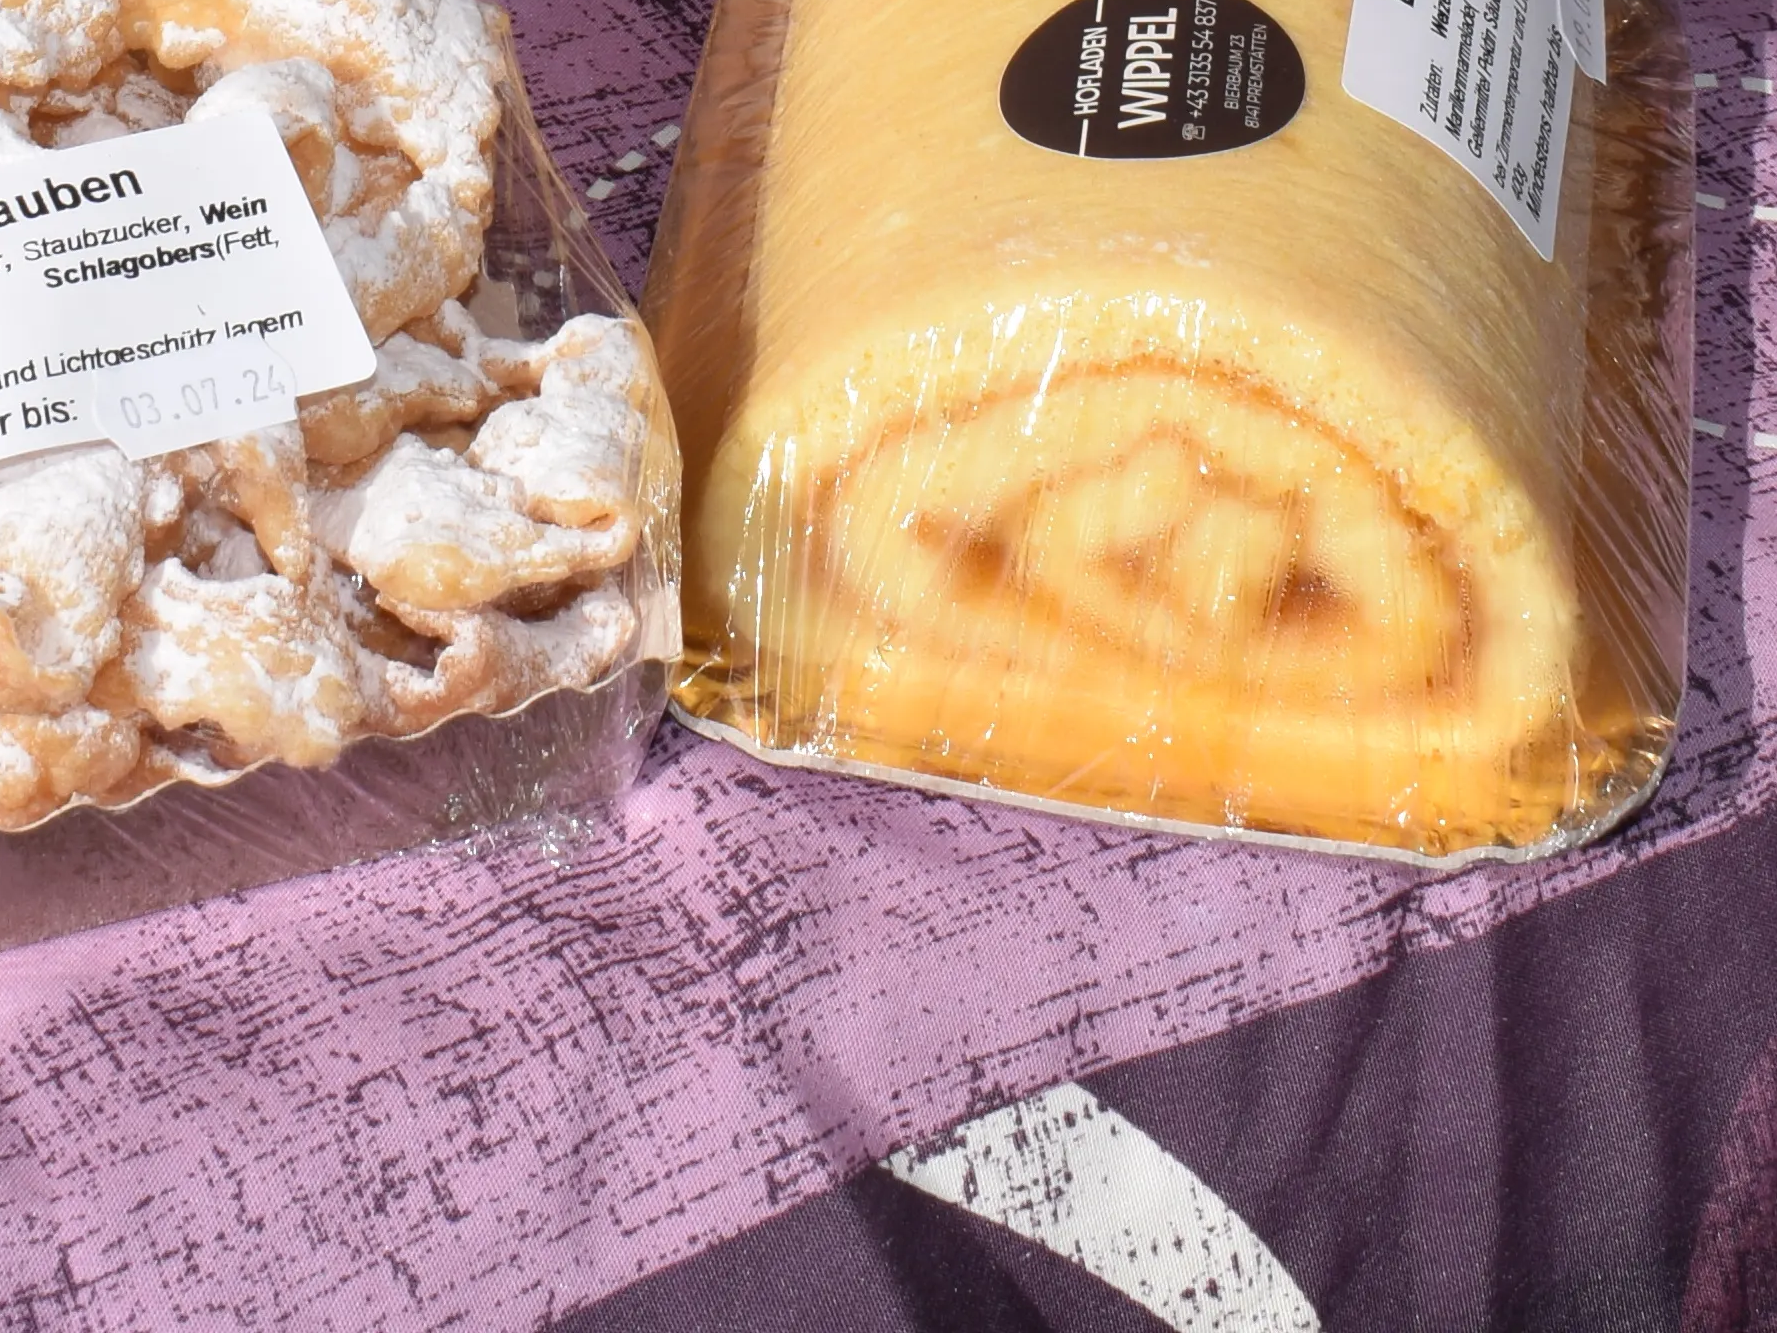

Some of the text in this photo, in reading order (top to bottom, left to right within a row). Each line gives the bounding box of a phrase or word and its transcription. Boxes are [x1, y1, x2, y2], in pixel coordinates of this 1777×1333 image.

[1075, 27, 1107, 114] HOFLADEN
[1119, 9, 1177, 128] WIPPEL
[1188, 53, 1212, 86] 3135
[1192, 29, 1214, 49] 54
[1478, 28, 1496, 77] Pektin
[1187, 89, 1209, 118] +43
[1224, 35, 1245, 109] BIERBAUM 23
[1420, 60, 1442, 122] Zutaten:
[1496, 37, 1522, 164] Zimmertemperatur
[1513, 8, 1526, 41] und
[1245, 105, 1260, 128] 8141
[1468, 71, 1490, 158] Geliermittel
[1527, 115, 1551, 221] Mindestens
[1540, 51, 1559, 119] haltbar
[1512, 163, 1528, 201] 400g
[23, 213, 190, 261] Staubzucker,
[200, 196, 268, 226] Wein
[22, 398, 78, 430] bis:
[120, 364, 288, 430] 03.07.24
